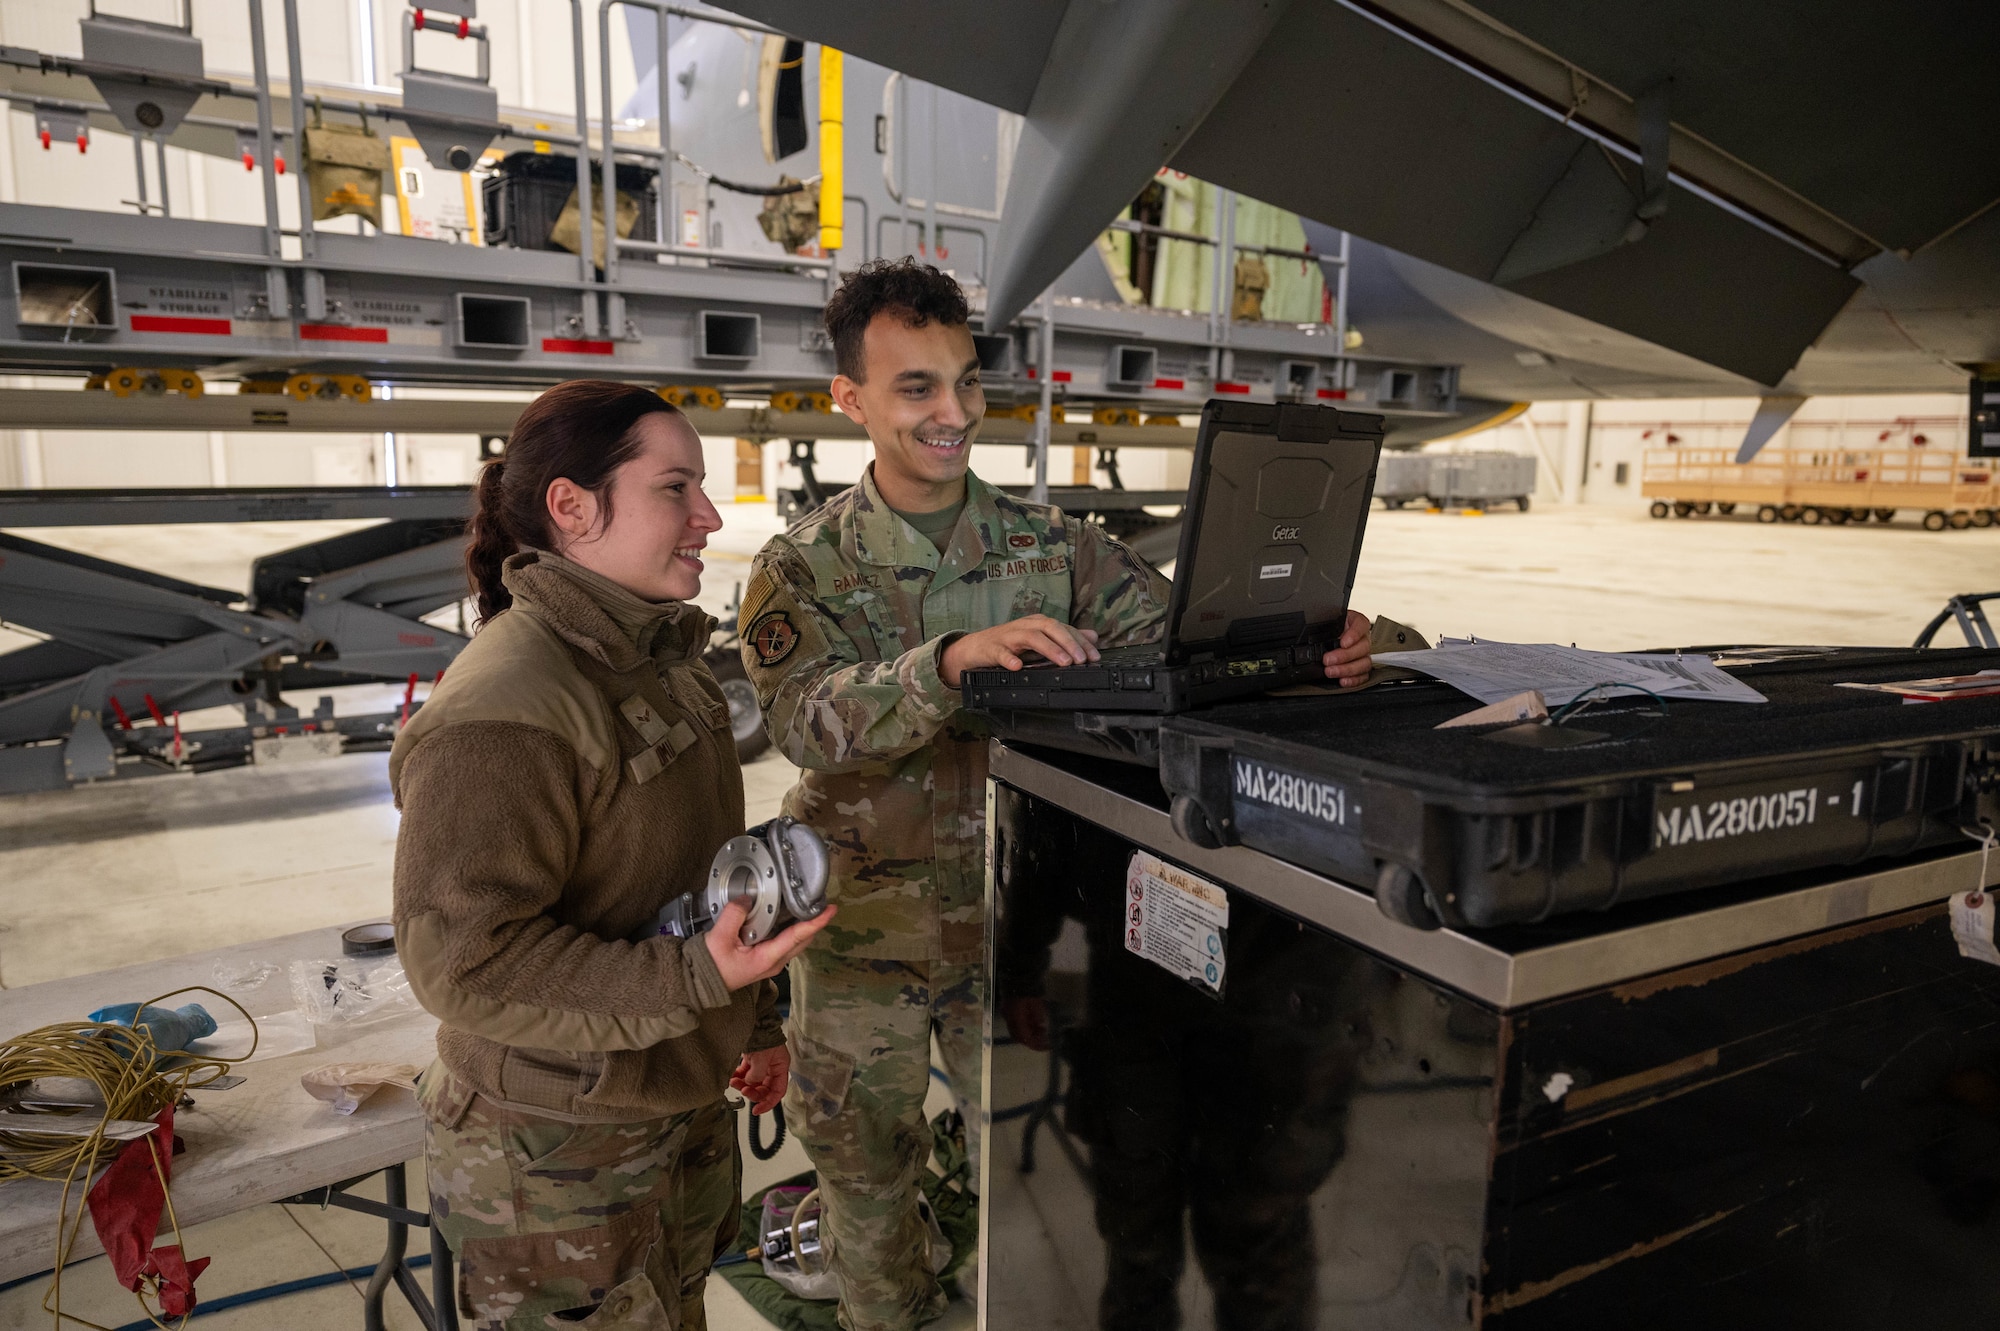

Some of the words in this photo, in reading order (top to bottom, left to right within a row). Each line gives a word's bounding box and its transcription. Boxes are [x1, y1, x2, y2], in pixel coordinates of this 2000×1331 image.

[149, 287, 229, 301] STABILIZER
[160, 302, 219, 313] STORAGE
[1272, 524, 1300, 540] Getac
[988, 563, 1001, 578] US
[1007, 560, 1027, 576] AIR
[1030, 555, 1066, 574] FORCE
[1236, 760, 1345, 825] MA280051
[1655, 787, 1818, 848] MA280051
[1852, 780, 1864, 816] 1
[1169, 872, 1211, 899] WARING
